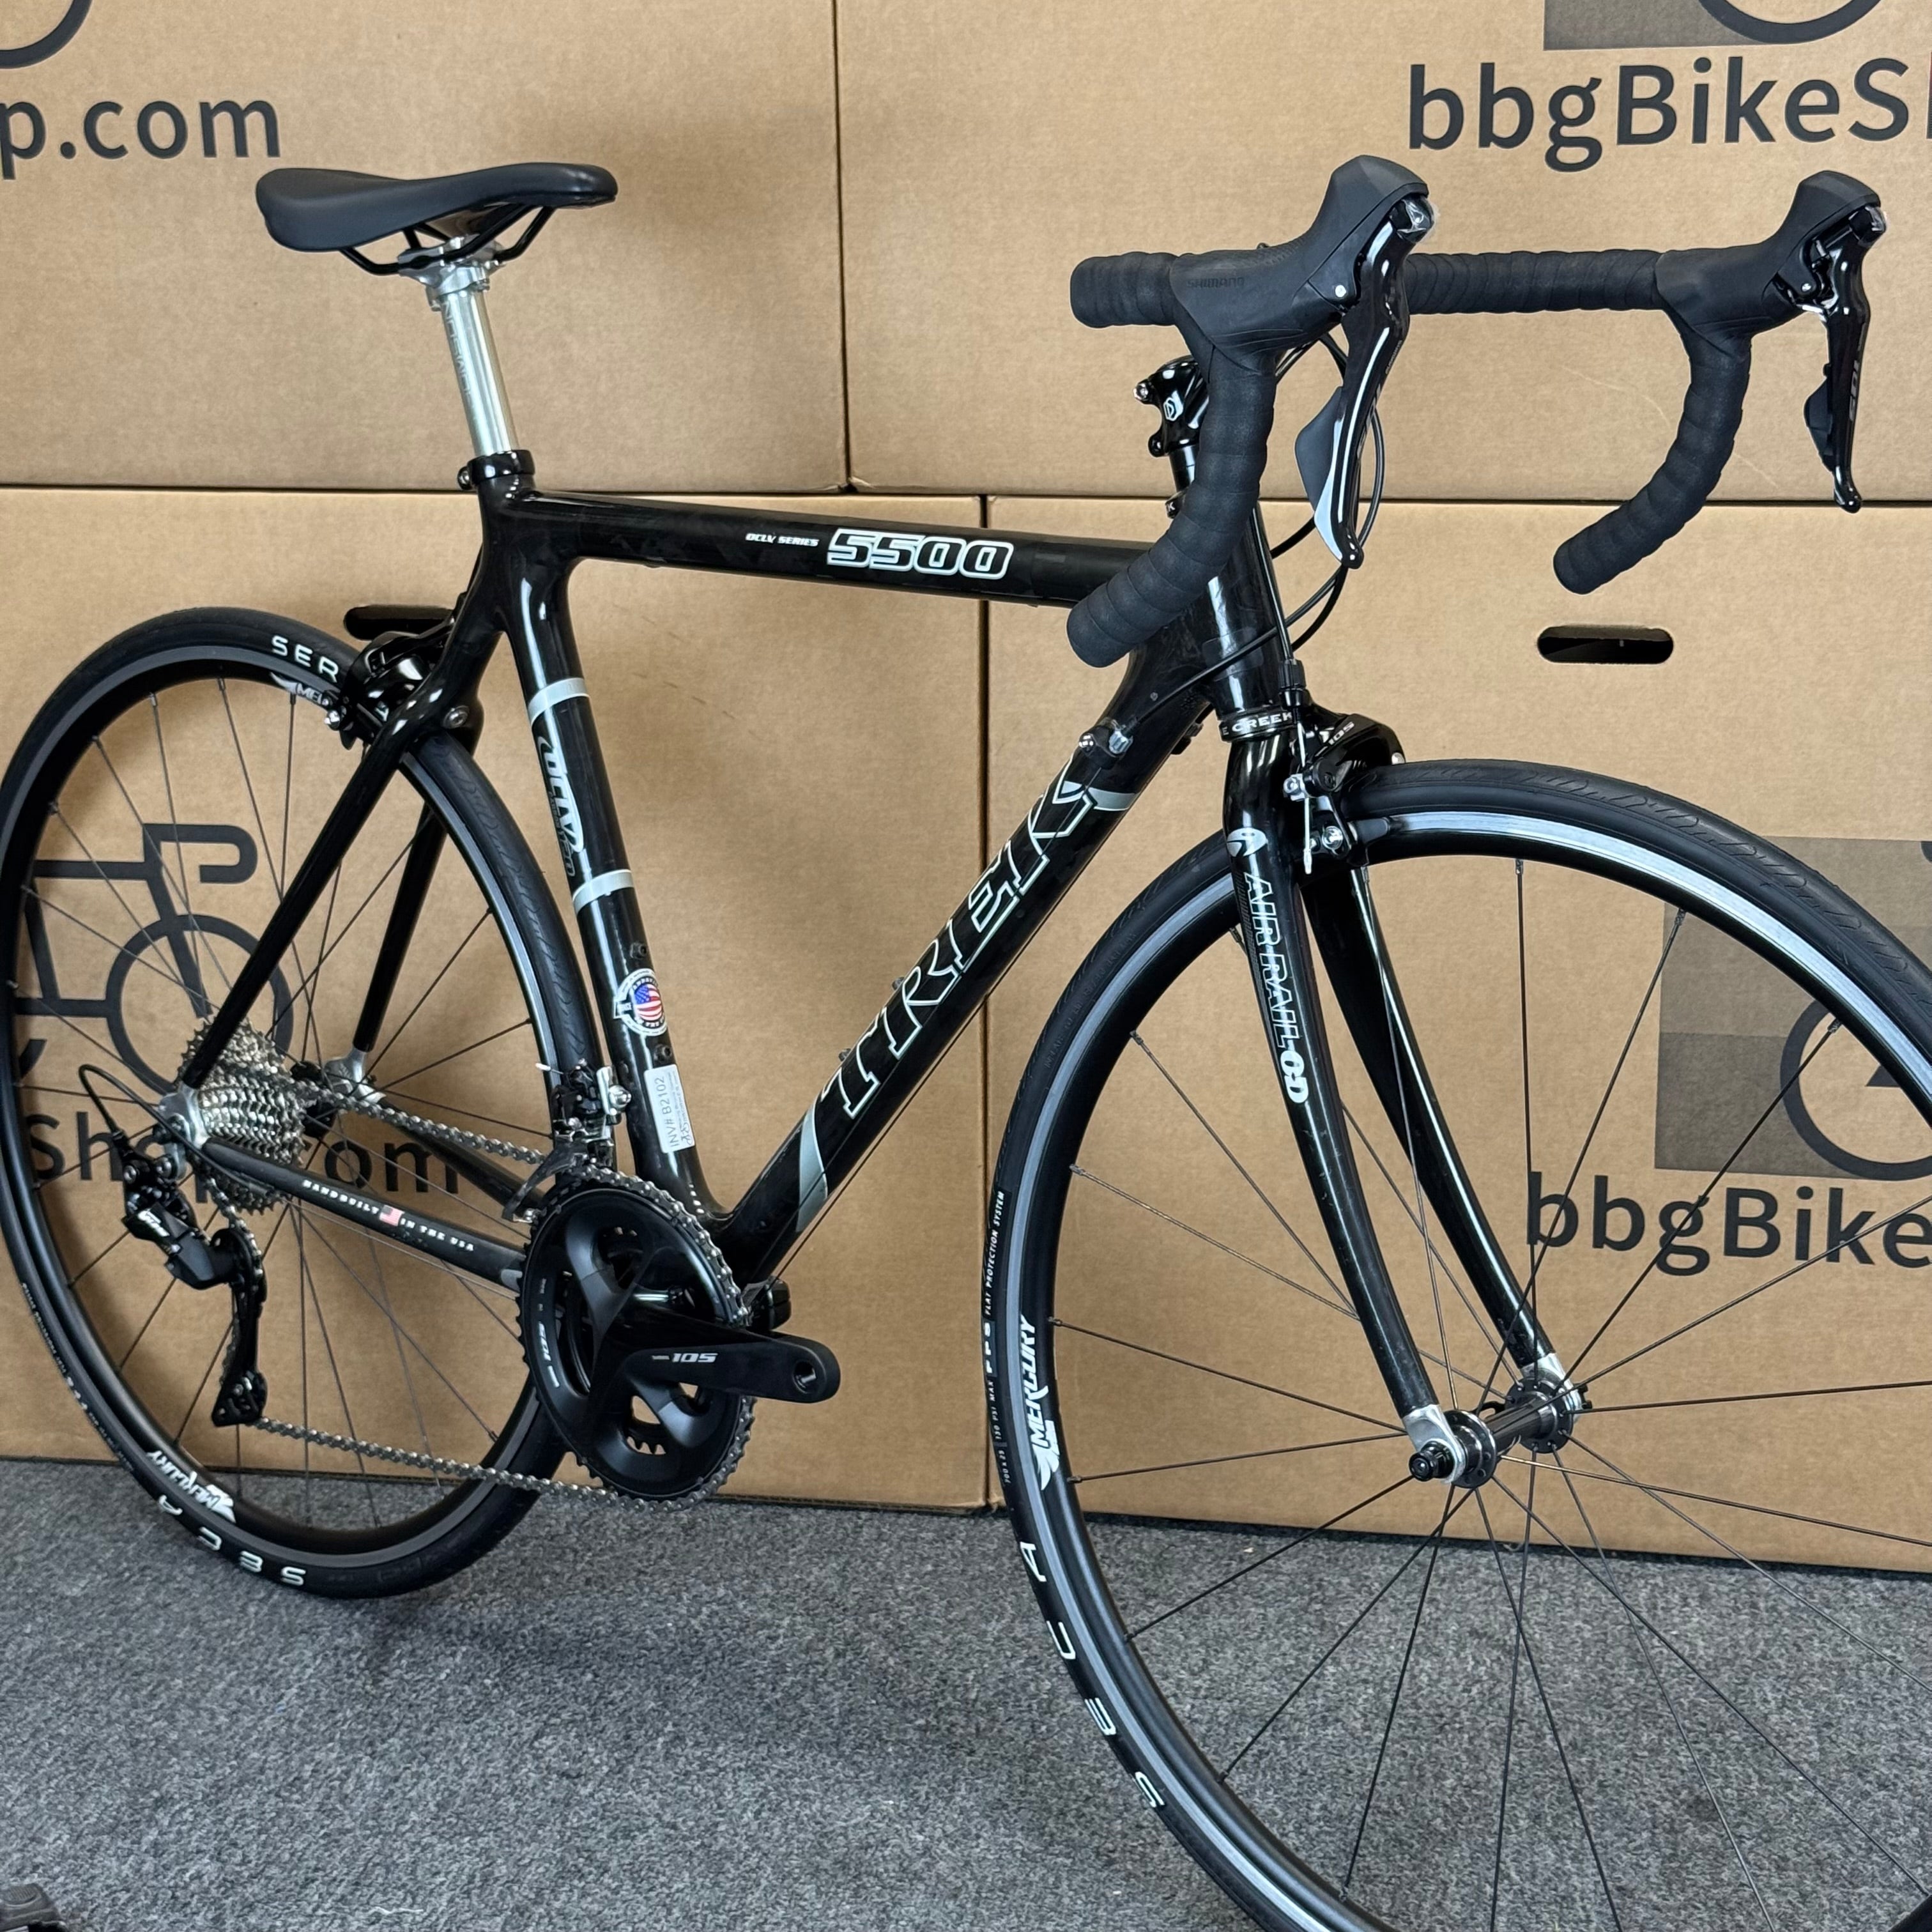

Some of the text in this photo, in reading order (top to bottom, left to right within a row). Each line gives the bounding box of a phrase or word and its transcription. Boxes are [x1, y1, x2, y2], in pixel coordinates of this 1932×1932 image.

[1409, 56, 1932, 172] bbgBikeS
[745, 533, 820, 547] OCLV SERIES
[827, 528, 1014, 579] 5500
[1232, 711, 1293, 733] CREEK
[1329, 721, 1355, 745] 105
[820, 754, 1094, 1119] TREK
[1243, 871, 1282, 947] AIR
[1259, 952, 1300, 1049] RAIL
[654, 1075, 673, 1116] B2102
[663, 1118, 681, 1148] INV#
[302, 1179, 474, 1252] HANDBUILT IN THE USA
[986, 1229, 999, 1289] PROTECTION
[993, 1191, 1005, 1227] SYSTEM
[672, 1353, 718, 1363] 105
[1020, 1314, 1051, 1448] MERCURY
